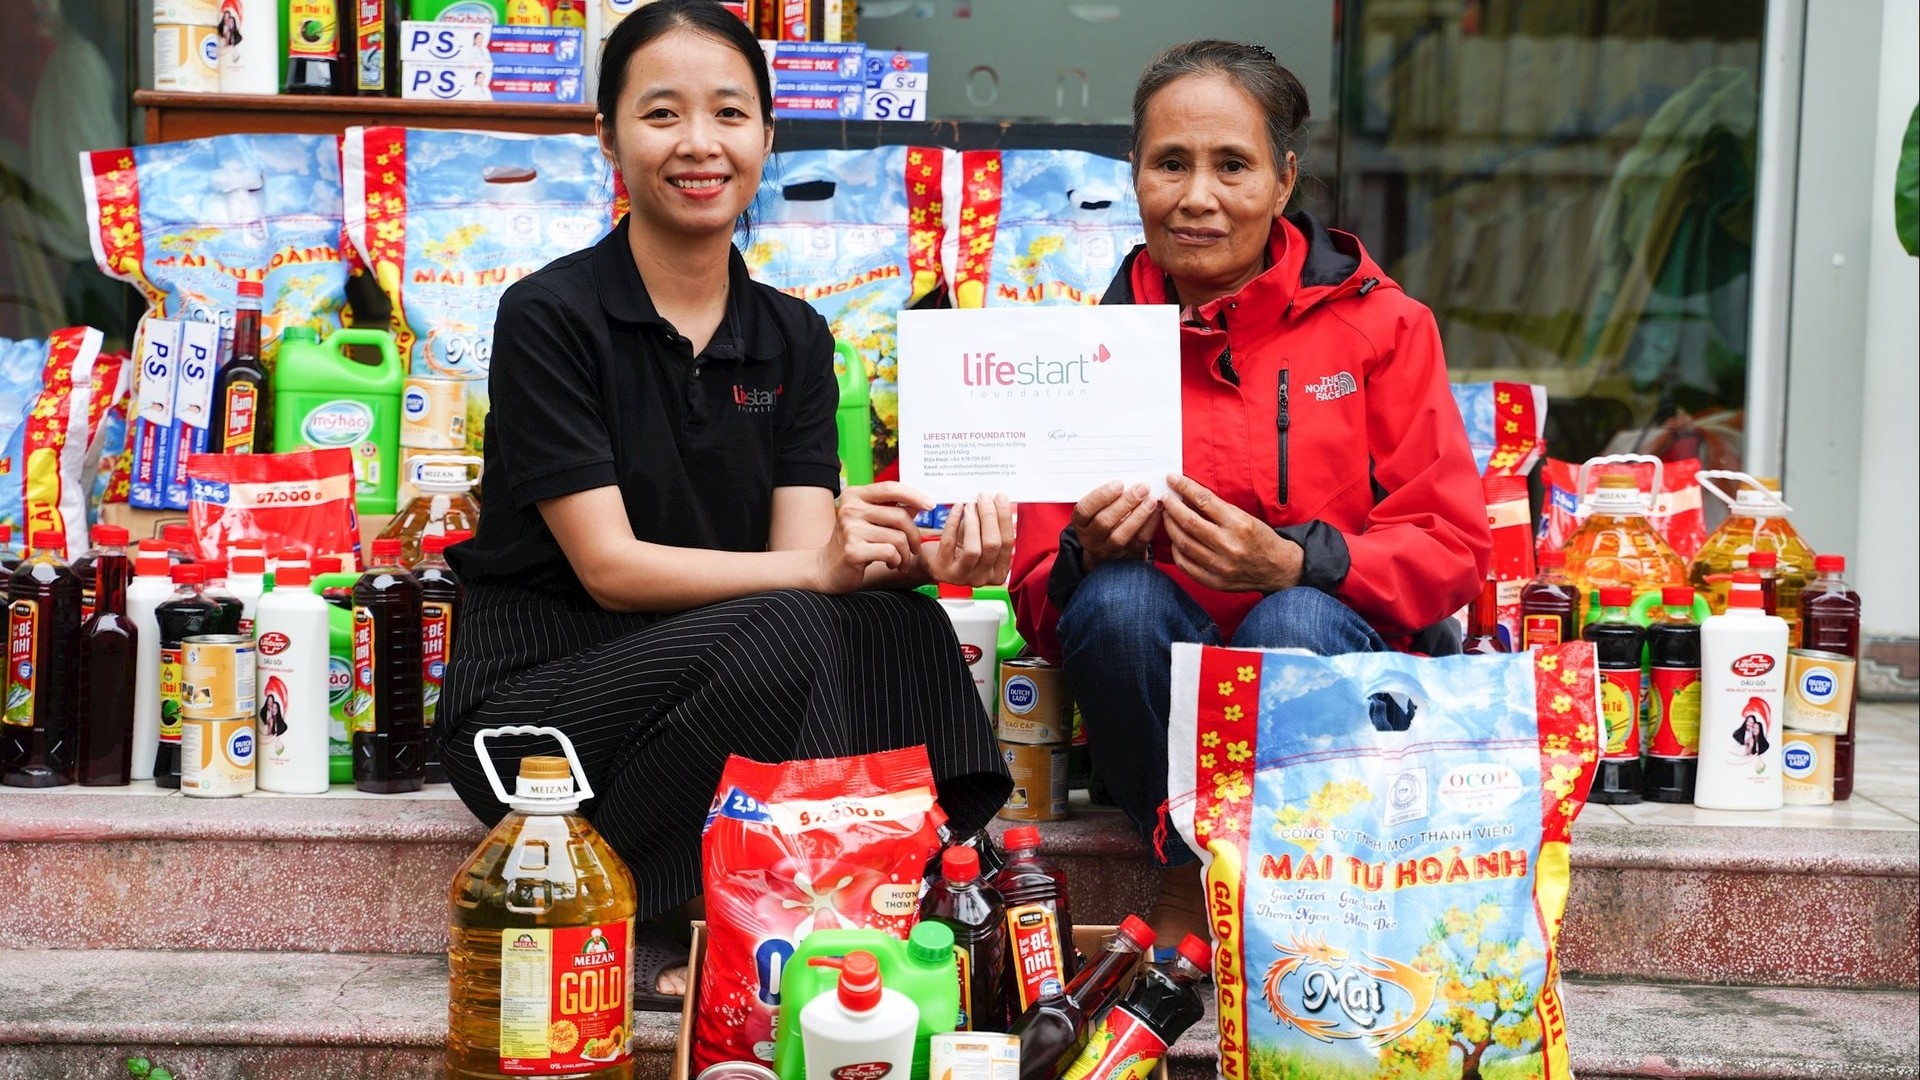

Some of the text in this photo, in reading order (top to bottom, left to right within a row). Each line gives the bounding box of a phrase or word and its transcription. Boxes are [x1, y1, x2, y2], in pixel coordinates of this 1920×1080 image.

[411, 30, 455, 53] PS
[412, 70, 456, 93] PS
[414, 267, 463, 286] MAI
[997, 283, 1044, 304] MAI
[189, 306, 236, 332] Ma
[148, 341, 169, 378] PS
[186, 343, 207, 381] PS
[445, 337, 492, 371] Ma
[963, 352, 1089, 386] lifestart
[1305, 381, 1340, 394] NORTH
[1320, 374, 1340, 385] THE
[970, 386, 1086, 399] foundation
[1316, 390, 1341, 401] FACE
[923, 431, 1026, 441] LIFESTART FOUNDATION
[256, 490, 311, 503] 97.000
[1808, 678, 1831, 688] DUTCH
[1810, 685, 1828, 693] LADY
[1010, 688, 1031, 696] DUTCH
[1789, 759, 1807, 767] LADY
[1450, 770, 1509, 788] OCOP
[530, 785, 569, 794] MEIZAN
[732, 795, 756, 813] 2,9
[1331, 830, 1349, 841] TY
[1261, 853, 1334, 881] MAI
[891, 891, 919, 899] HƯƠN
[1212, 880, 1233, 940] GẠO
[1295, 907, 1330, 925] Ngon
[574, 952, 616, 967] MEIZAN
[560, 966, 622, 1015] GOLD
[1302, 969, 1384, 1027] Mai
[550, 1061, 595, 1070] 0% CHOLESTEROL
[837, 1066, 885, 1078] Lifebuoy
